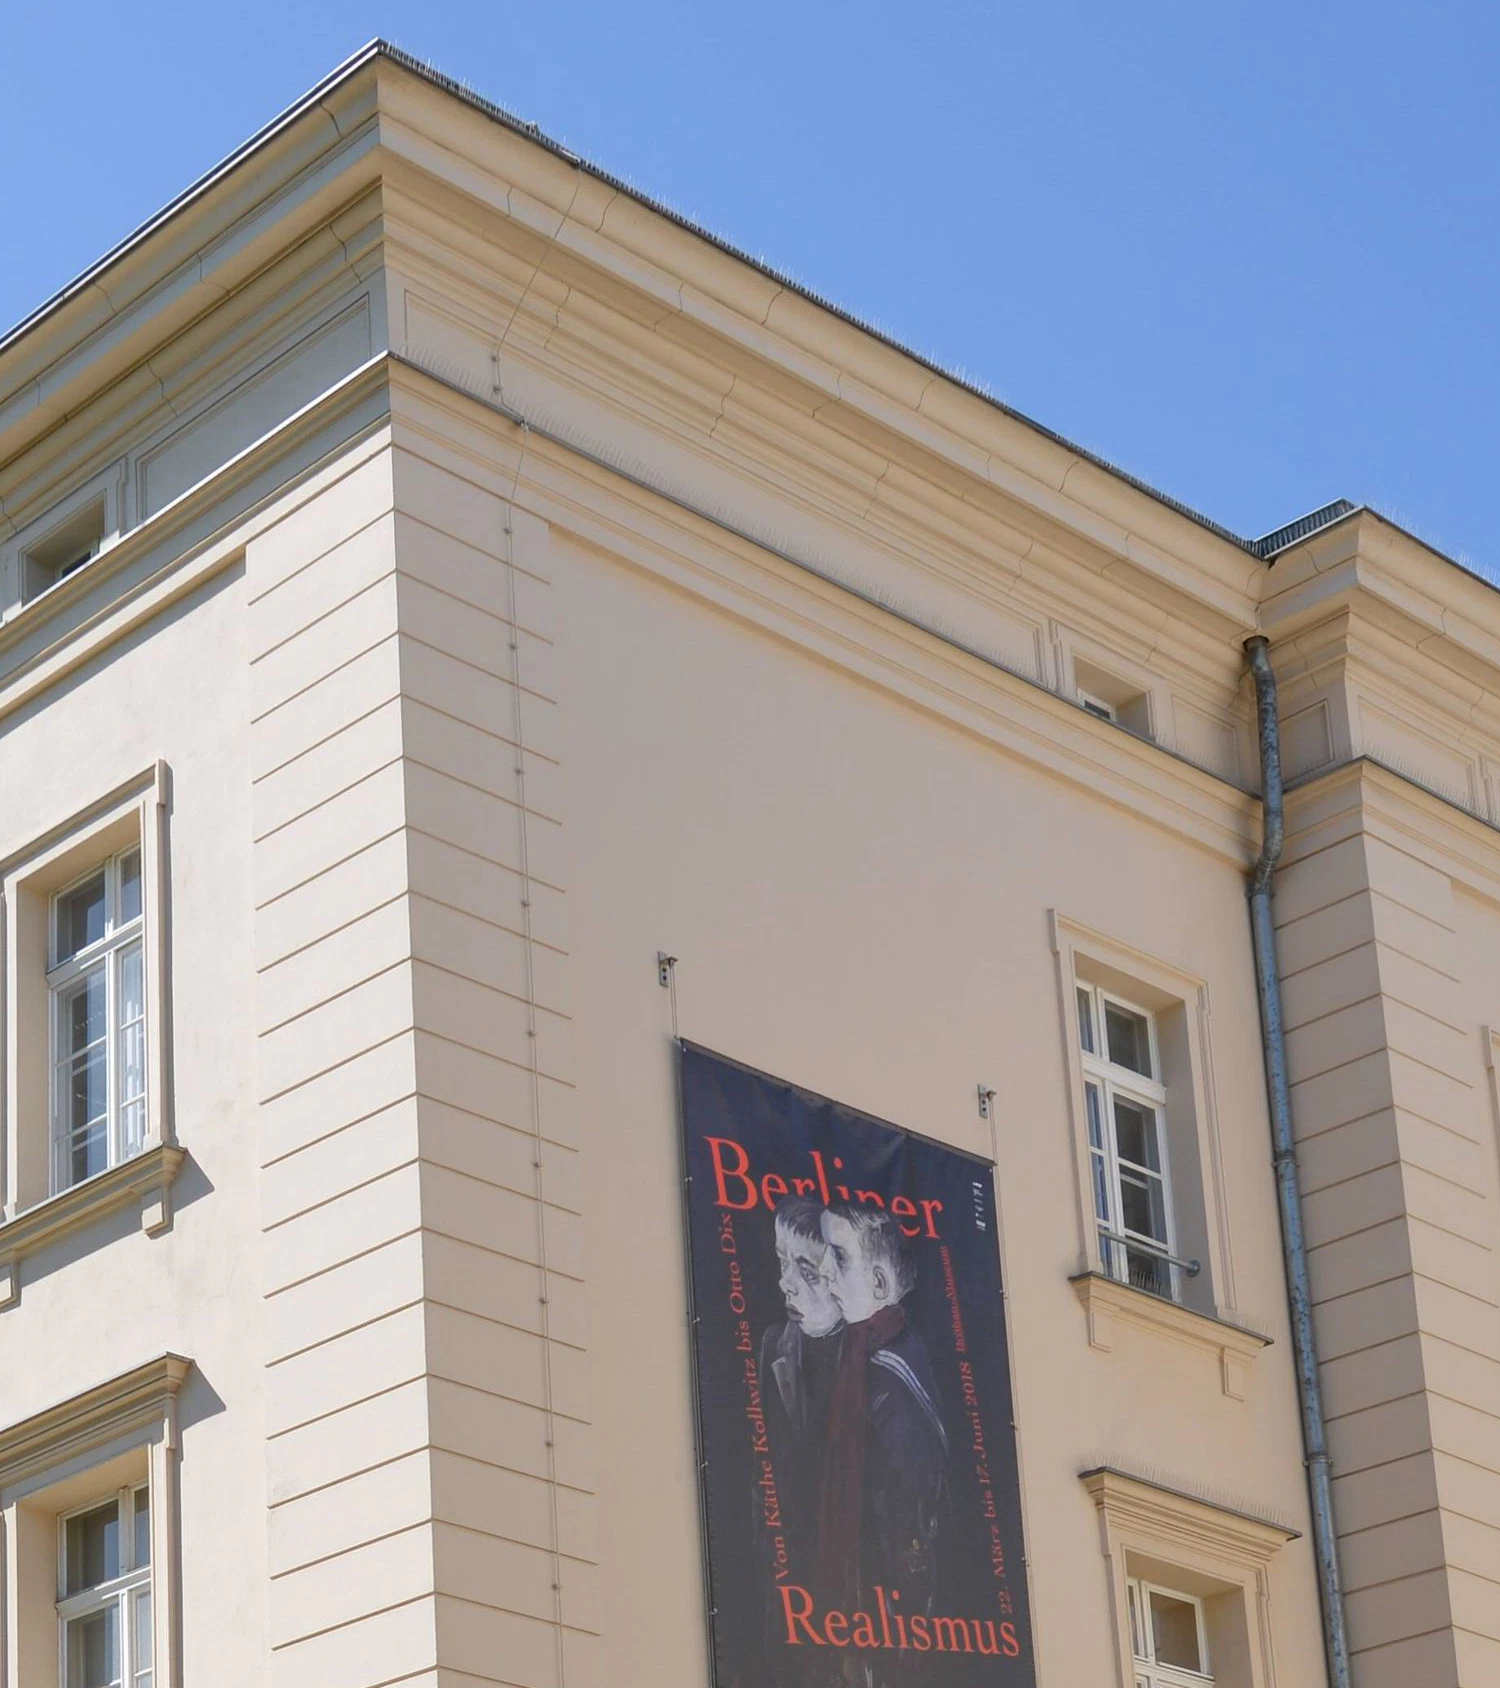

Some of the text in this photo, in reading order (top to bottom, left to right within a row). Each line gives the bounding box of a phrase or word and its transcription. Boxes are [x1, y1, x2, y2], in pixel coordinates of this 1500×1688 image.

[719, 1213, 789, 1580] Von Käthe Kollwitz bis Otto Dix
[960, 1362, 977, 1406] 2018
[966, 1411, 986, 1459] Juni
[982, 1490, 996, 1518] bis
[776, 1585, 1019, 1657] Realismus
